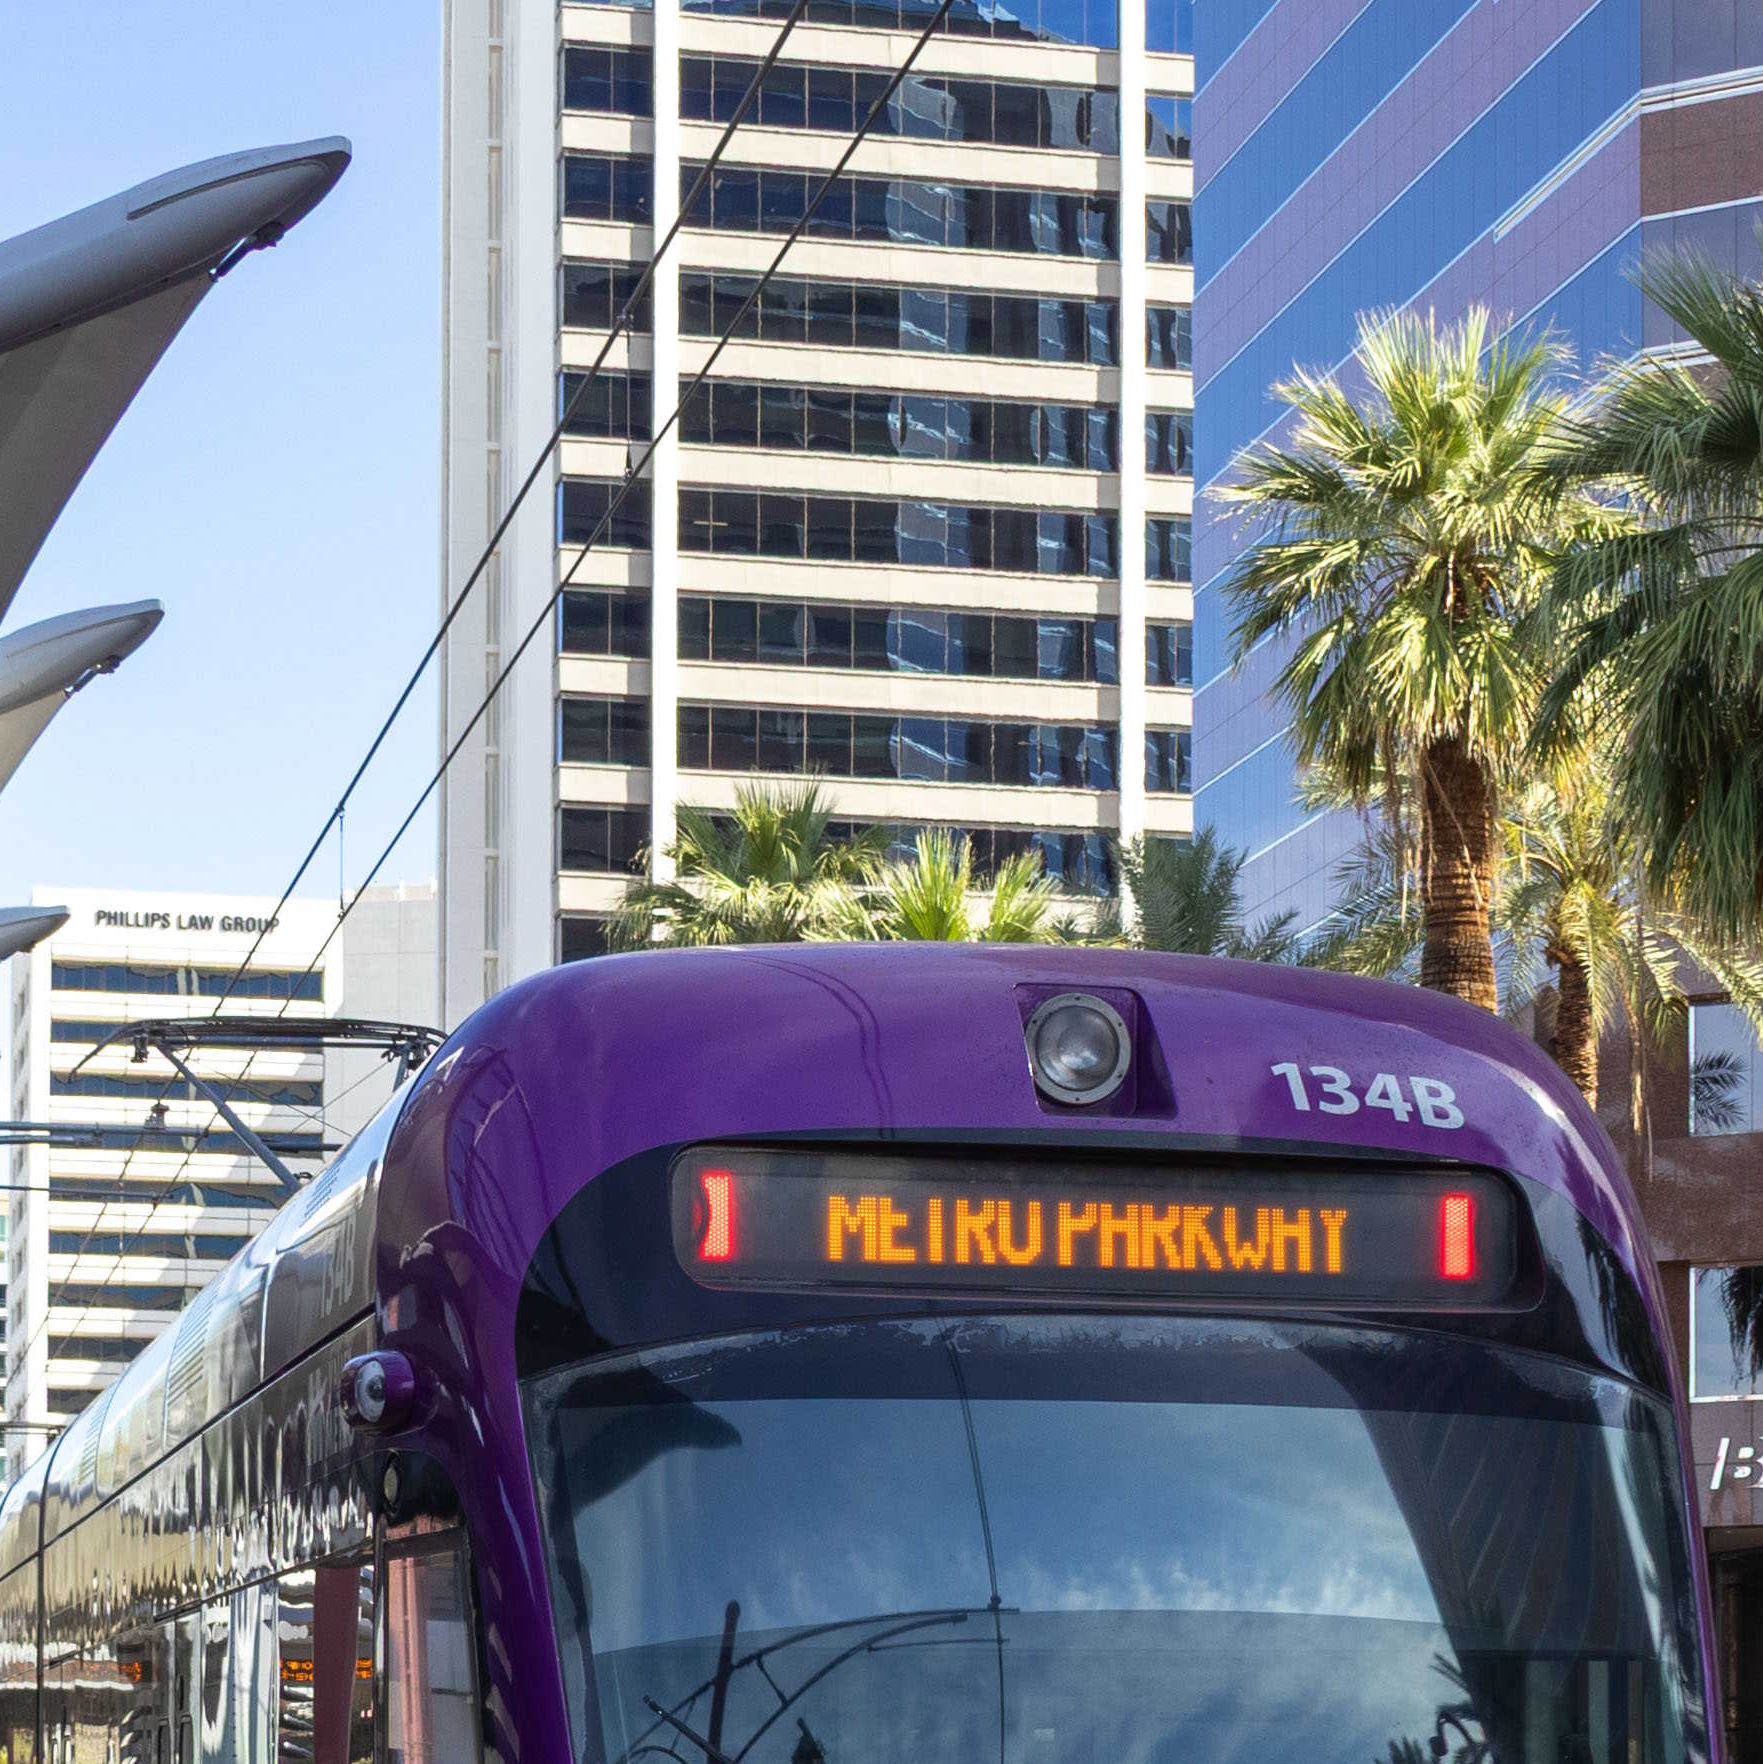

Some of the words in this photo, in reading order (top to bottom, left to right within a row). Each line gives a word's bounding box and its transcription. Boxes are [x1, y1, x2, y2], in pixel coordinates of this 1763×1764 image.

[95, 910, 171, 929] PHILLIPS
[177, 914, 214, 931] LAW
[220, 915, 279, 934] GROUP
[1271, 1062, 1465, 1129] 134B
